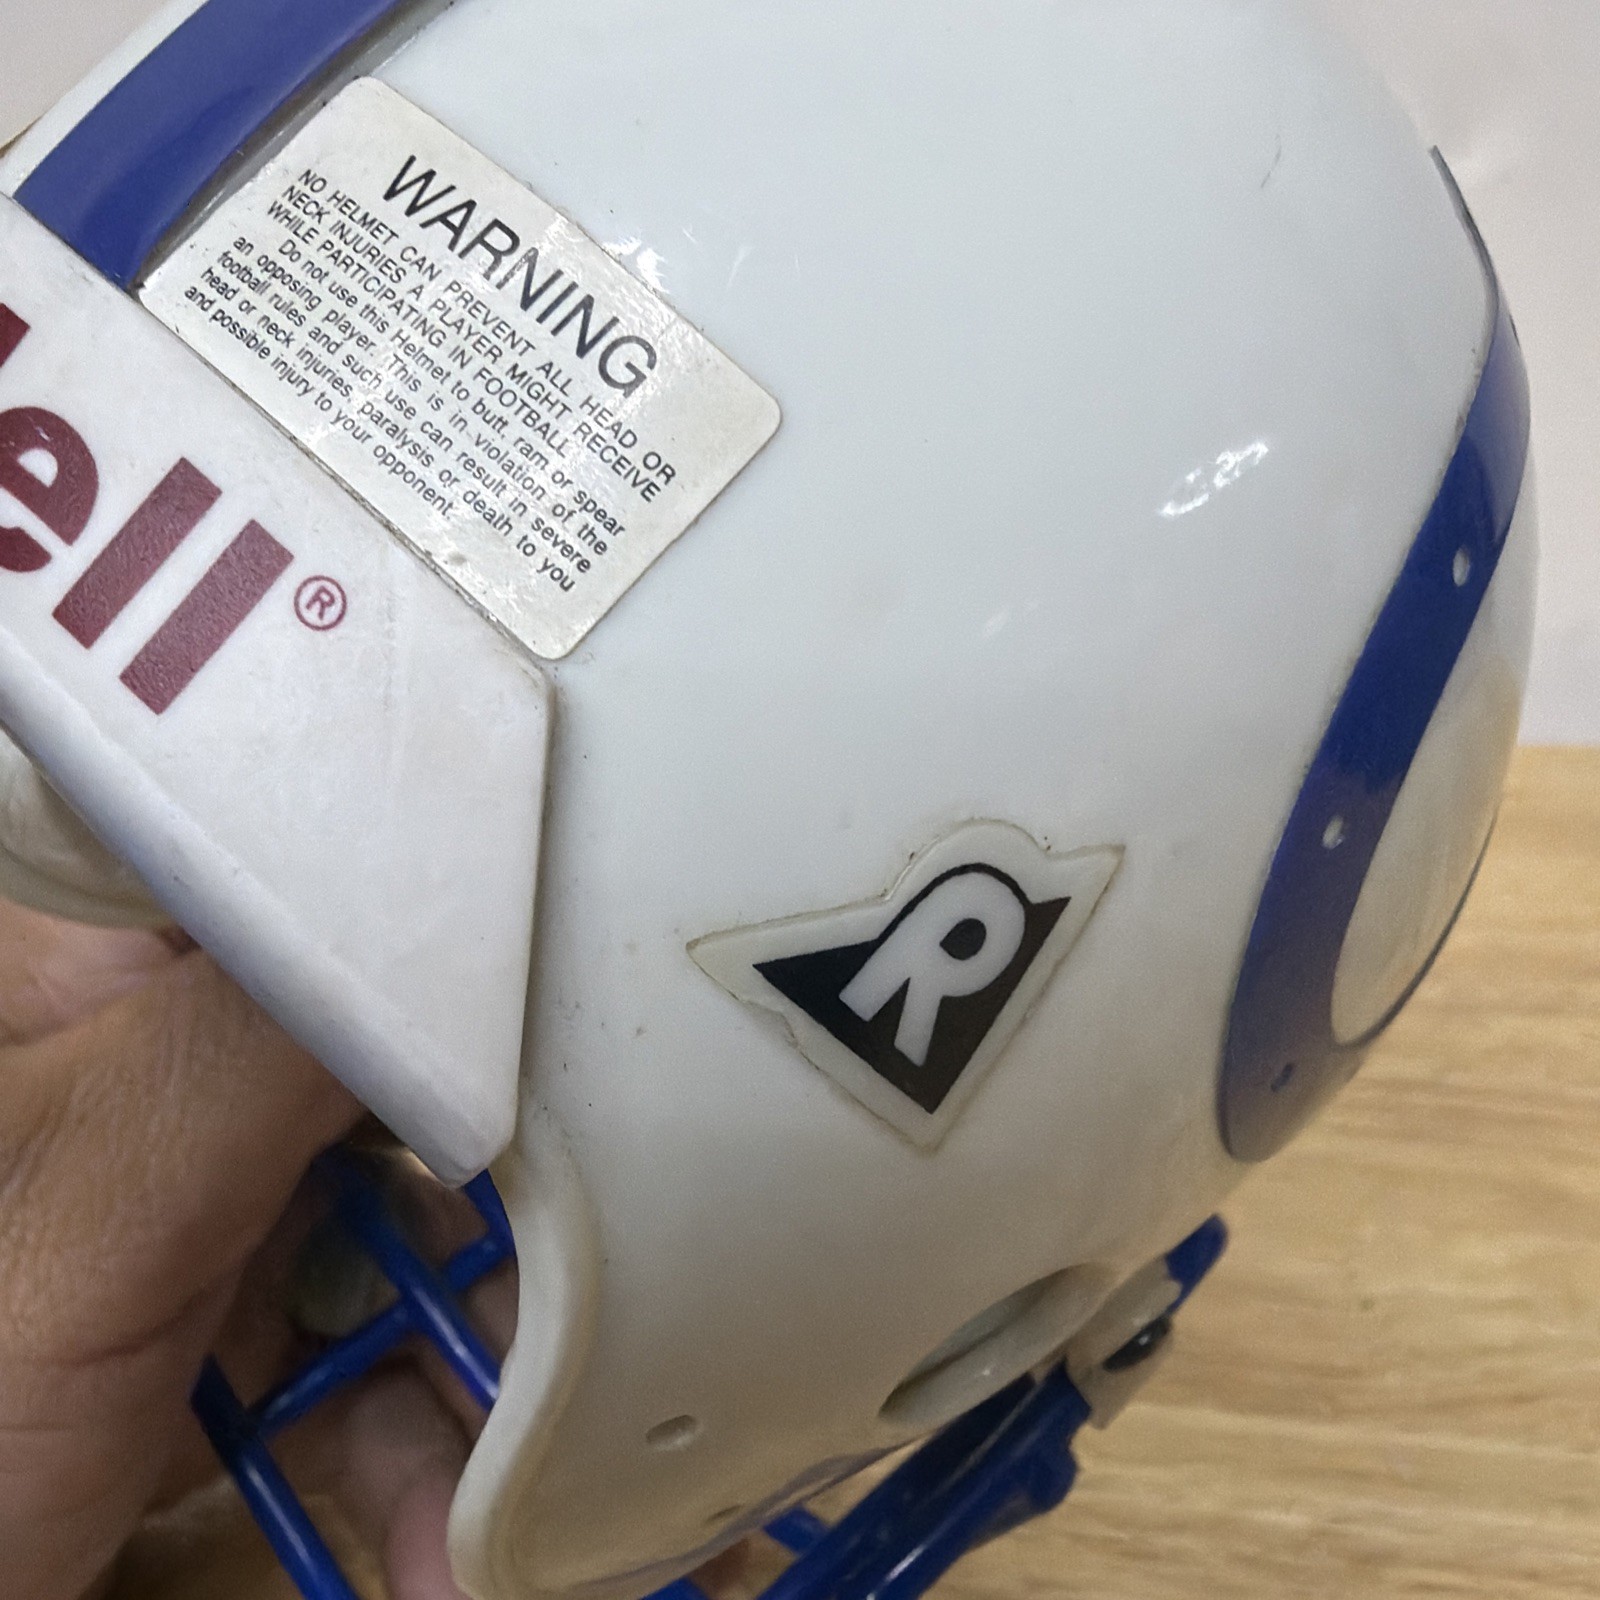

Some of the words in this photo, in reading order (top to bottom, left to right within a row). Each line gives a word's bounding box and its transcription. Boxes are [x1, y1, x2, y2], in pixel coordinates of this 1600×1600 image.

[184, 286, 216, 311] and
[209, 308, 270, 359] possible
[270, 353, 314, 396] injury
[314, 391, 332, 411] to
[329, 408, 372, 443] your
[200, 266, 239, 300] head
[238, 299, 257, 315] or
[257, 314, 295, 348] neck
[356, 401, 434, 467] paralysis
[438, 469, 460, 487] or
[462, 490, 512, 536] death
[515, 534, 536, 556] to
[536, 557, 575, 592] you
[217, 250, 270, 295] football
[268, 293, 306, 326] rules
[307, 326, 343, 355] and
[341, 354, 381, 389] such
[384, 388, 416, 419] use
[419, 420, 453, 452] can
[455, 451, 506, 498] result
[508, 493, 527, 517] in
[531, 517, 590, 573] severe
[232, 236, 254, 255] an
[257, 254, 321, 311] opposing
[380, 353, 421, 392] This
[426, 390, 444, 411] is
[448, 408, 467, 433] in
[474, 433, 546, 500] violation
[551, 503, 576, 527] of
[576, 522, 607, 555] the
[267, 200, 319, 244] WHILE
[317, 239, 446, 347] PARTICIPATING
[447, 345, 472, 369] IN
[473, 367, 568, 457] FOOTBALL
[278, 238, 301, 262] Do
[300, 259, 329, 284] not
[328, 281, 357, 307] use
[358, 303, 389, 333] this
[389, 328, 451, 384] Helmet
[450, 379, 470, 401] to
[513, 436, 549, 470] ram
[550, 469, 573, 488] or
[572, 490, 625, 535] spear
[281, 185, 330, 224] NECK
[329, 220, 406, 283] INJURIES
[406, 283, 424, 301] A
[428, 298, 502, 364] PLAYER
[505, 363, 572, 419] MIGHT
[572, 421, 660, 502] RECEIVE
[297, 168, 327, 192] NO
[327, 190, 399, 244] HELMET
[399, 245, 442, 281] CAN
[443, 280, 535, 356] PREVENT
[535, 361, 572, 396] ALL
[579, 394, 637, 448] HEAD
[642, 451, 675, 485] OR
[382, 154, 657, 397] WARNING
[838, 872, 1026, 1067] R
